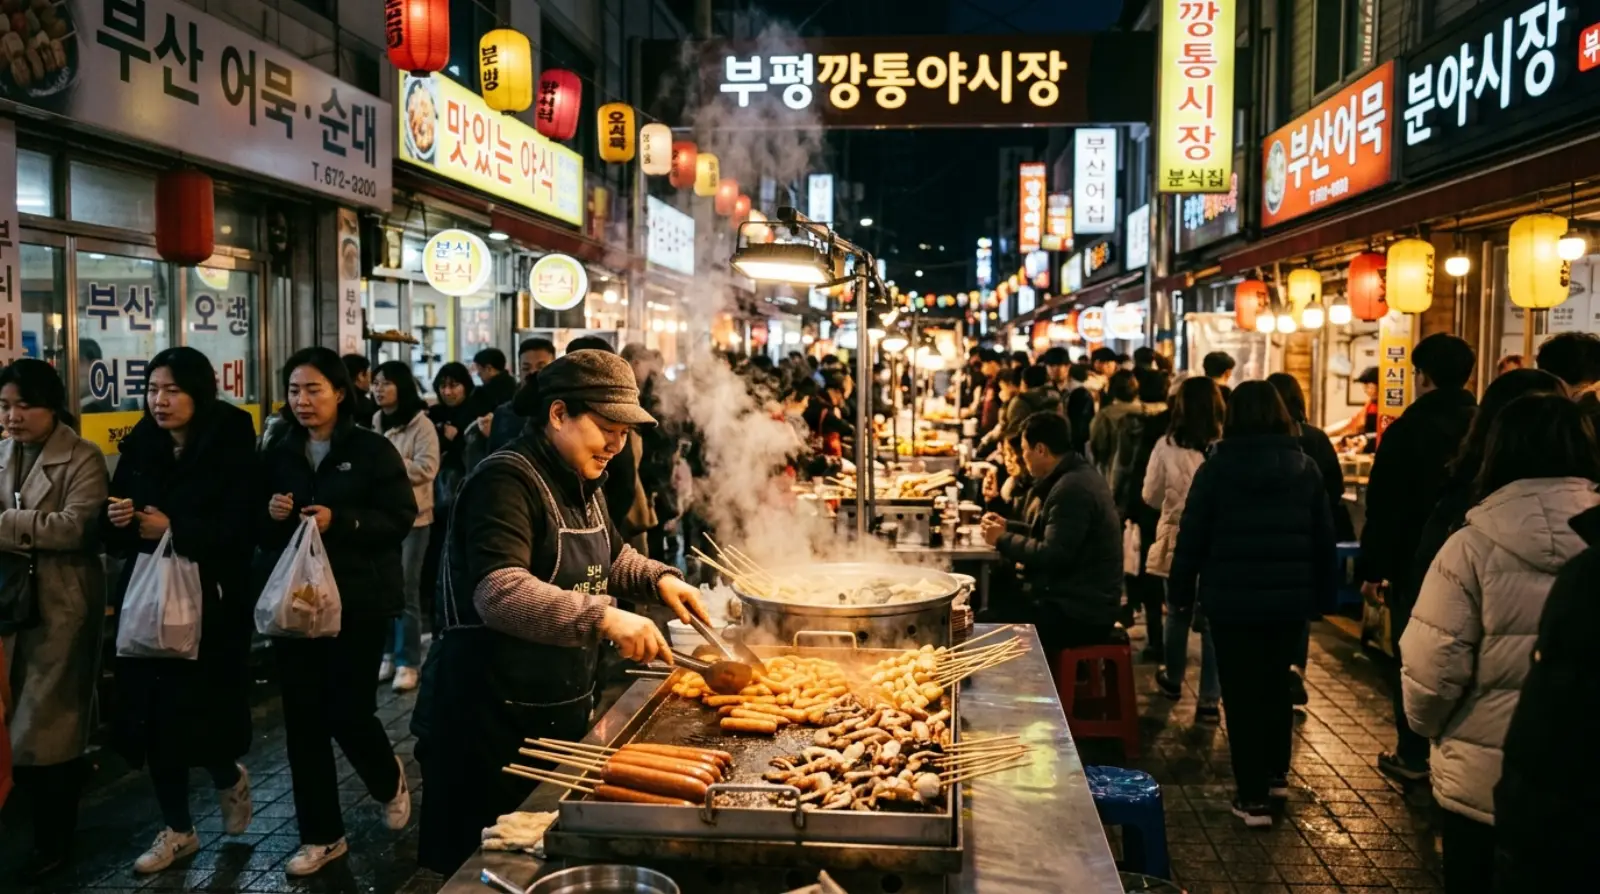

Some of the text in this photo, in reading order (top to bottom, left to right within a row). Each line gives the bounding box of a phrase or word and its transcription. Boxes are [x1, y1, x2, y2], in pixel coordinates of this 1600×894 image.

[97, 0, 203, 105] 부산
[719, 50, 1068, 110] 부평깡통야시장
[1178, 2, 1218, 161] 깡통시장
[1404, 0, 1566, 146] 분야시장
[448, 100, 514, 184] 맛있는
[521, 141, 554, 202] 야식
[1167, 169, 1225, 187] 분식집
[1288, 80, 1386, 188] 부산어묵
[87, 284, 153, 331] 부산
[214, 359, 244, 398] 대
